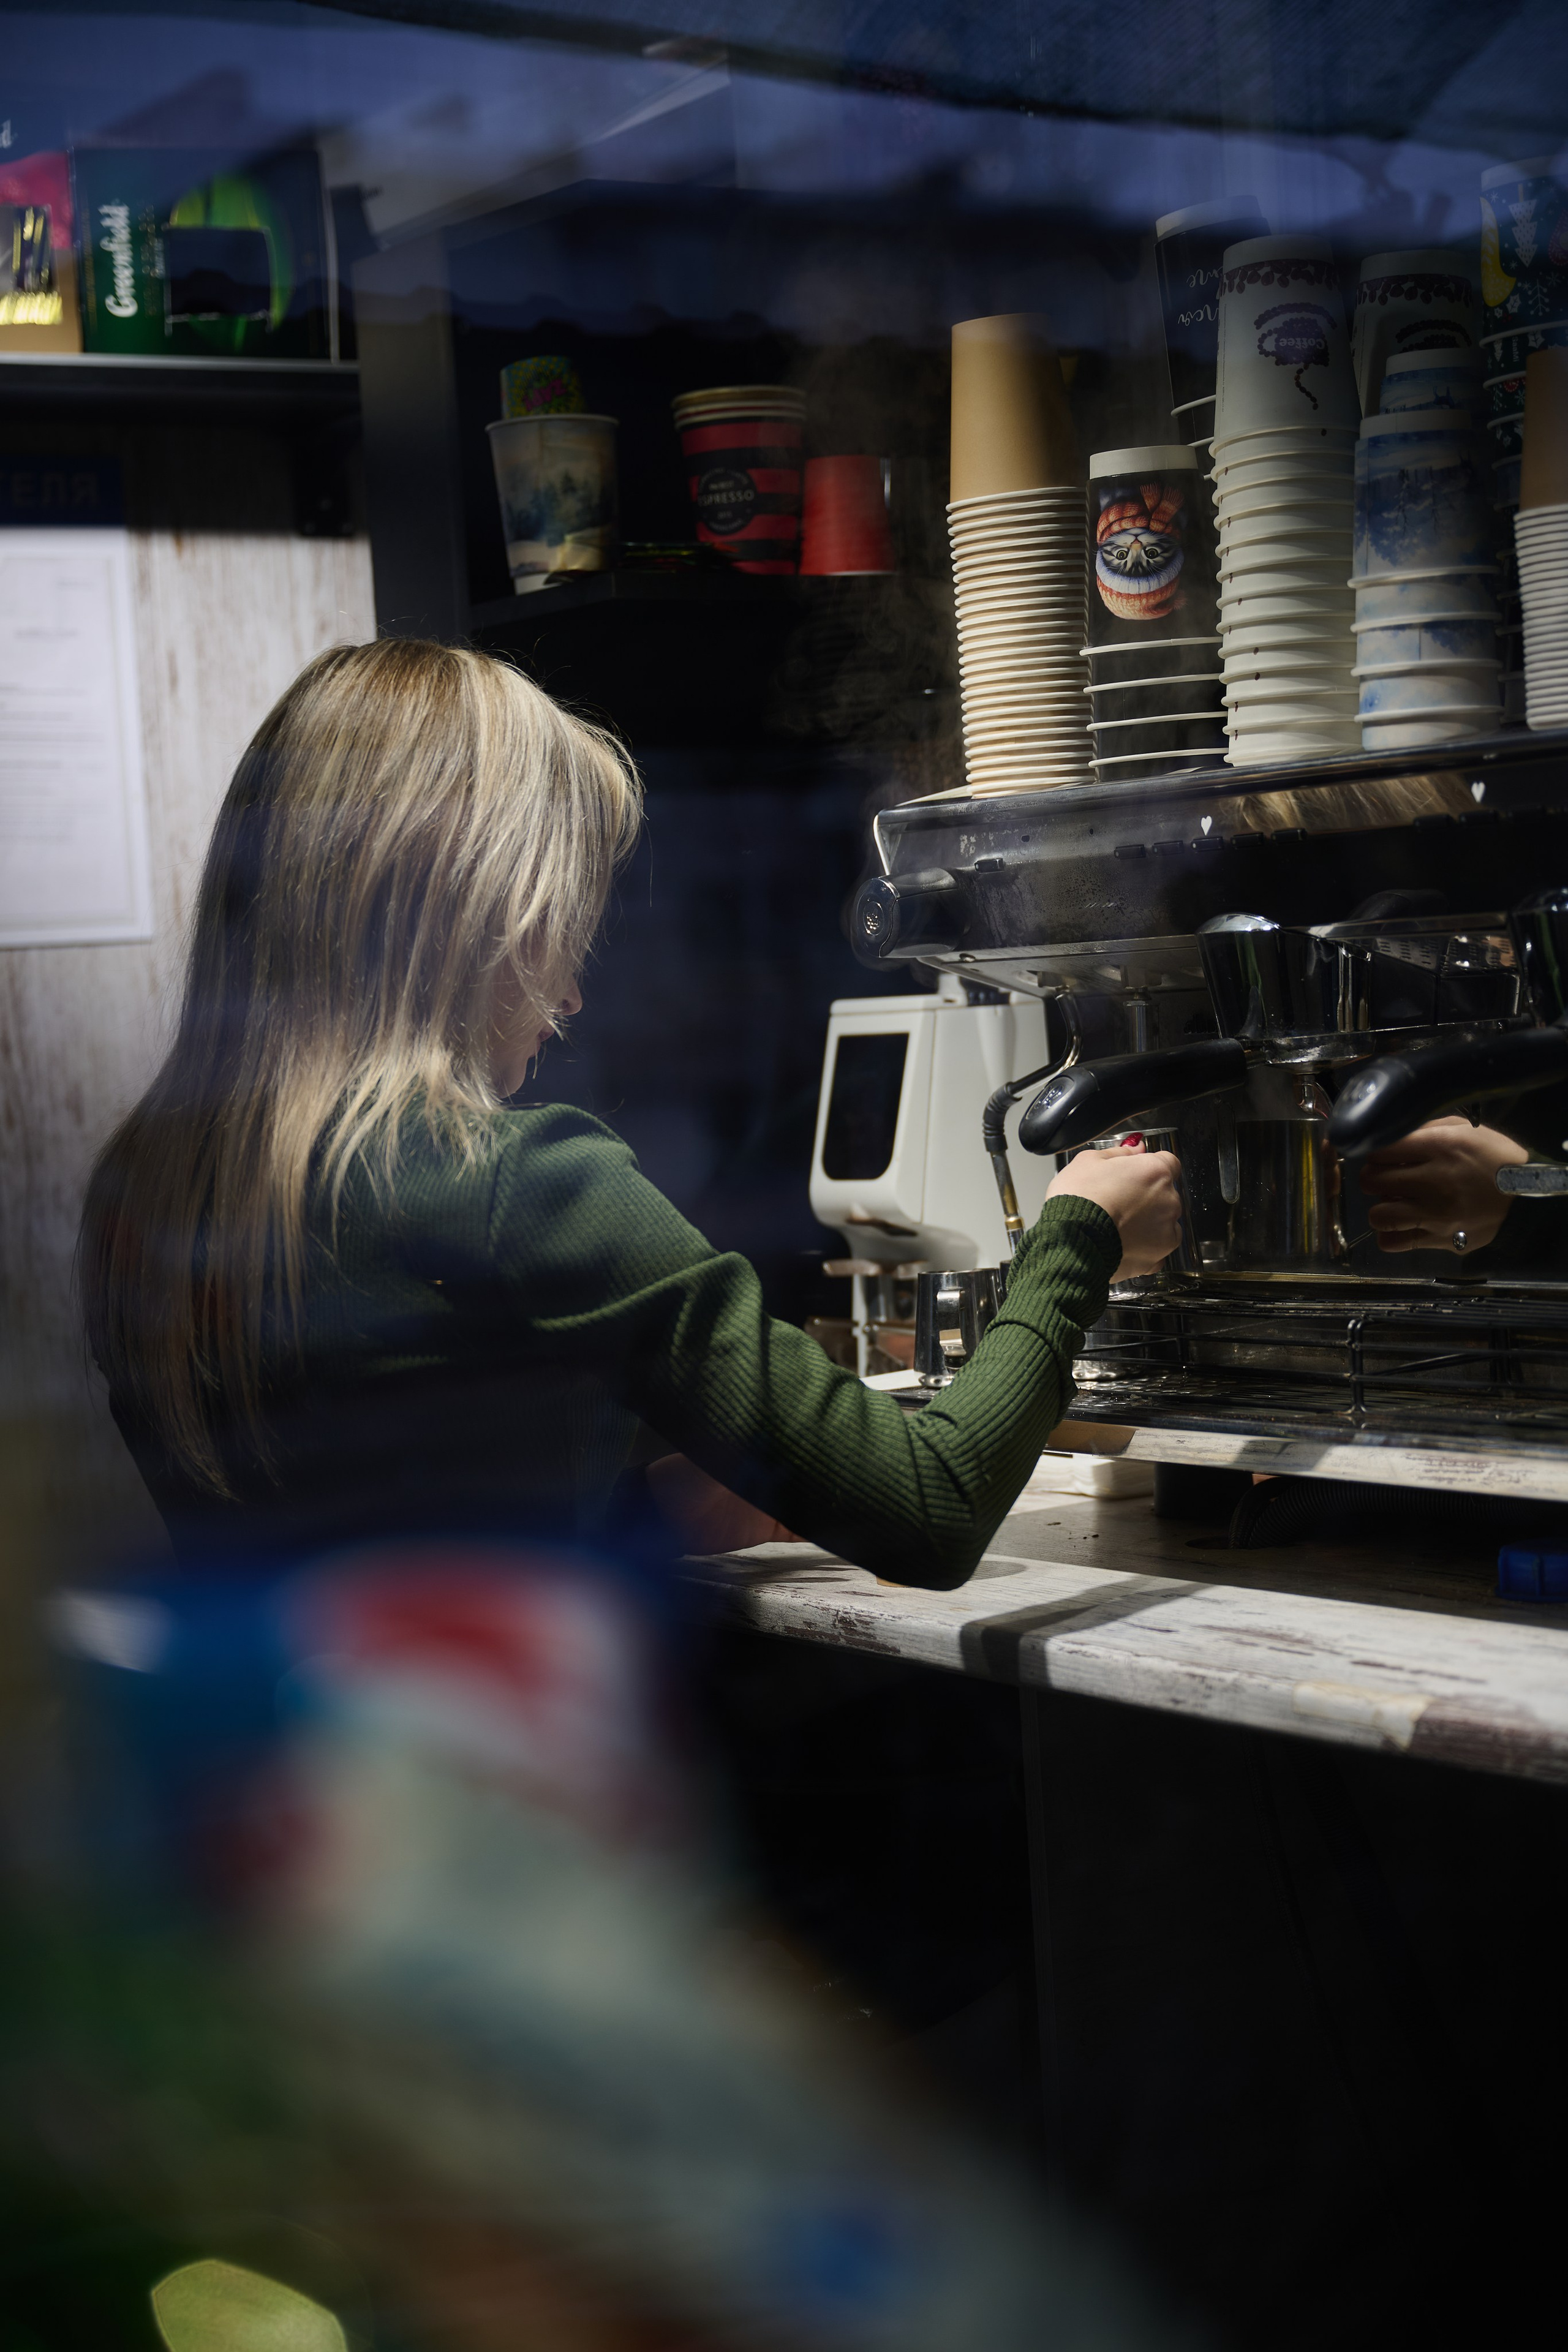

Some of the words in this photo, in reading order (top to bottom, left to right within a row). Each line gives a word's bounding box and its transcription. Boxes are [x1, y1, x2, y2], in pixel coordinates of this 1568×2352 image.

[98, 203, 138, 318] Greenfield
[1280, 337, 1325, 350] Coffee
[698, 488, 755, 507] ESPRESSO
